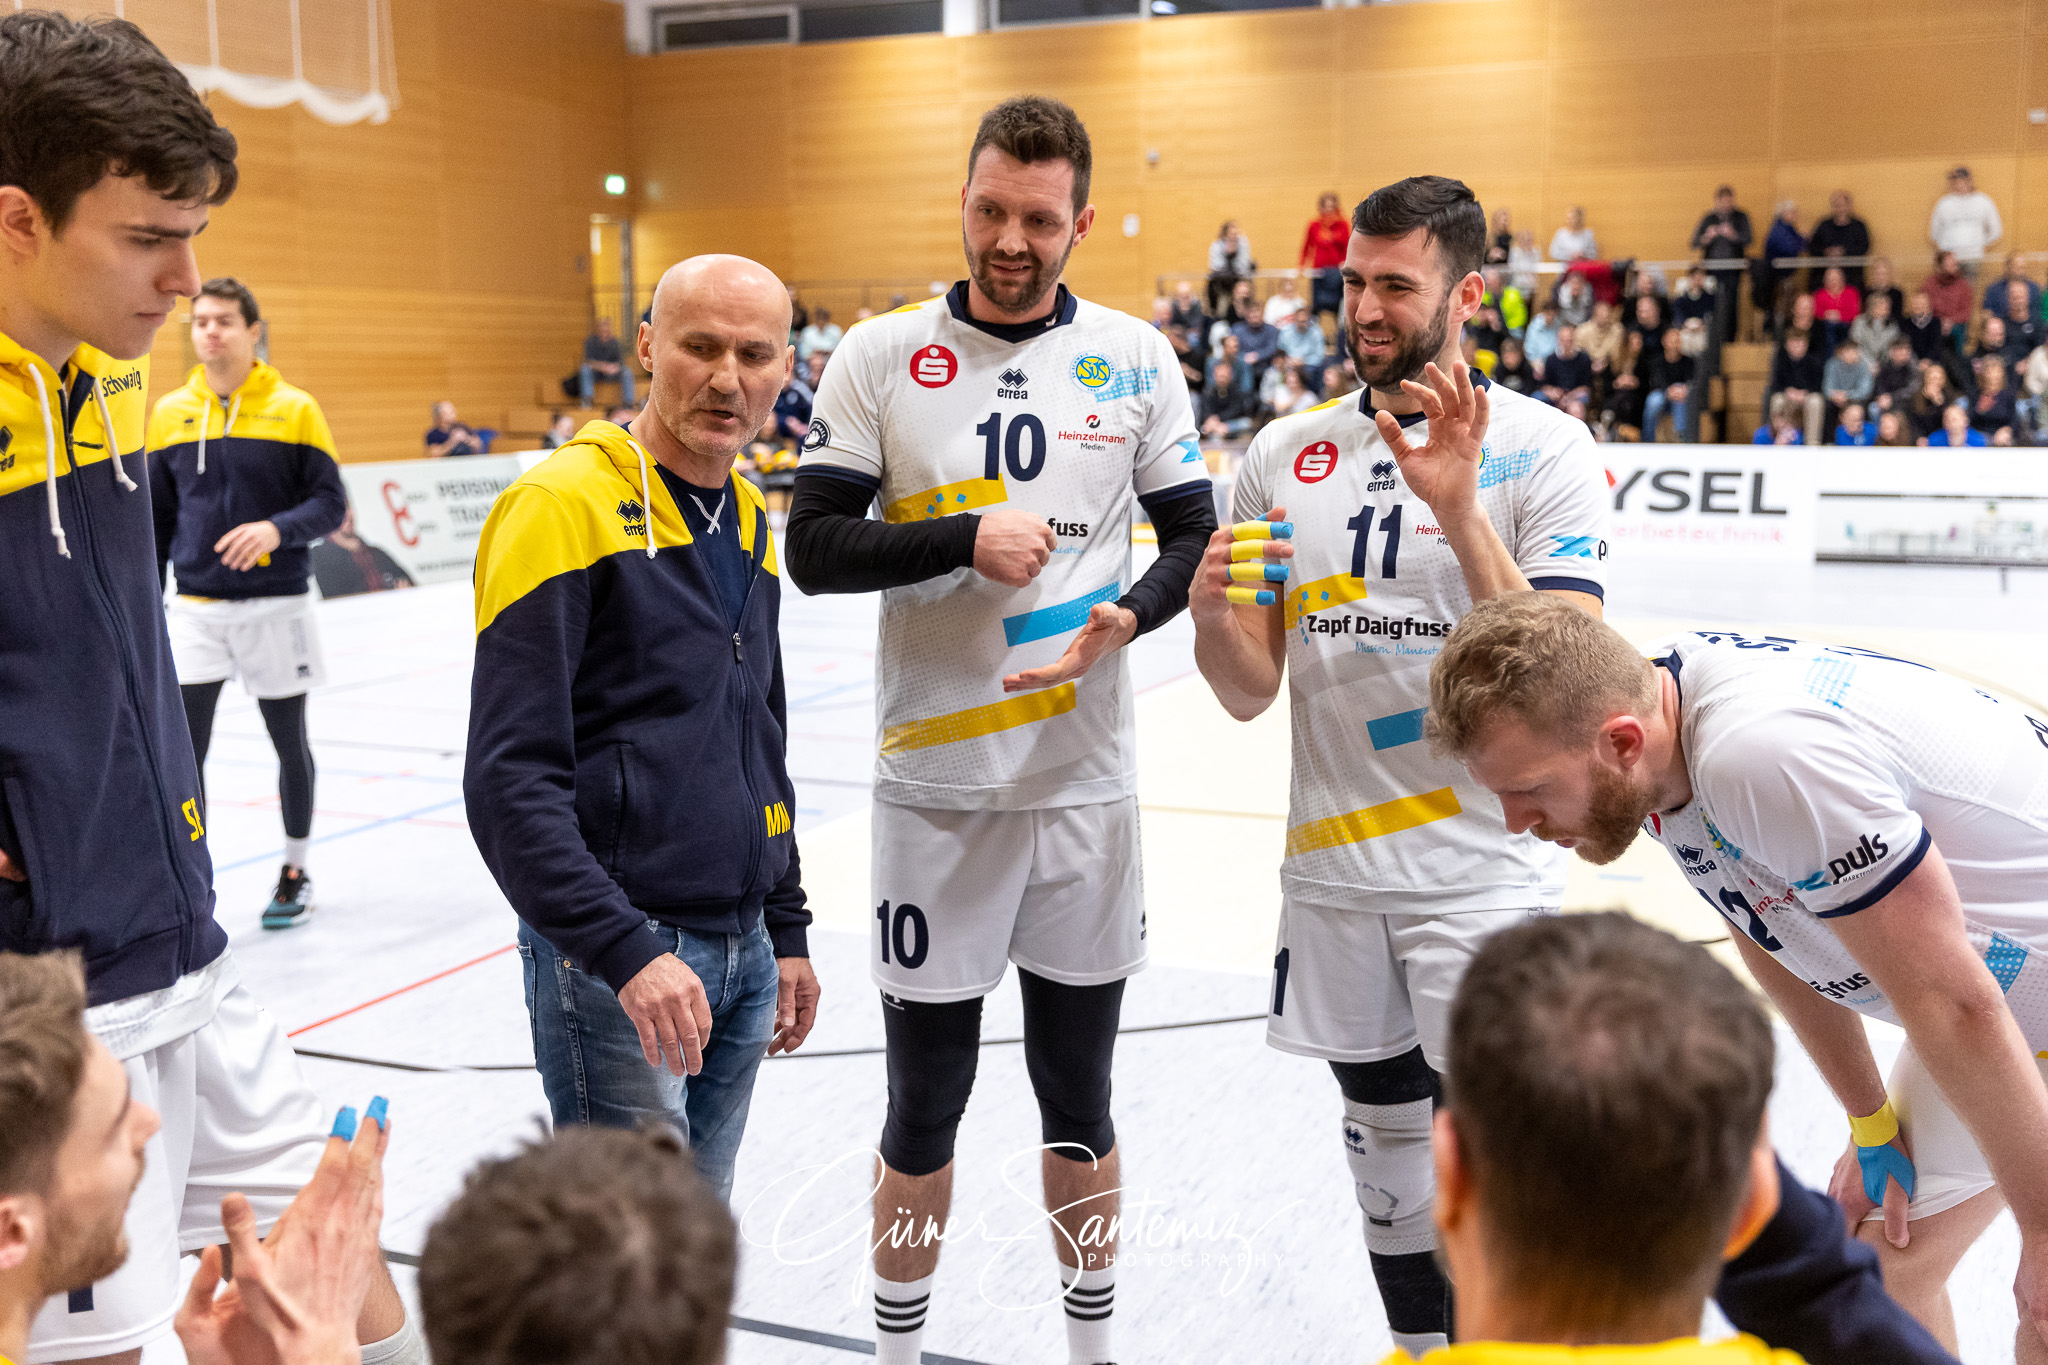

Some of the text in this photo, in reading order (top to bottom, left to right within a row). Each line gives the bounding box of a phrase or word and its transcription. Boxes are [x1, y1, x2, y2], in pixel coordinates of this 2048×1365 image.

[102, 367, 142, 398] Schwaig
[997, 388, 1028, 400] errea
[976, 412, 1047, 482] 10
[1058, 430, 1126, 444] Heinzelmann
[1080, 442, 1106, 451] Medien
[1367, 479, 1396, 492] errea
[1347, 504, 1403, 580] 11
[1307, 614, 1352, 638] Zapf
[1828, 833, 1888, 886] puls
[876, 898, 930, 970] 10
